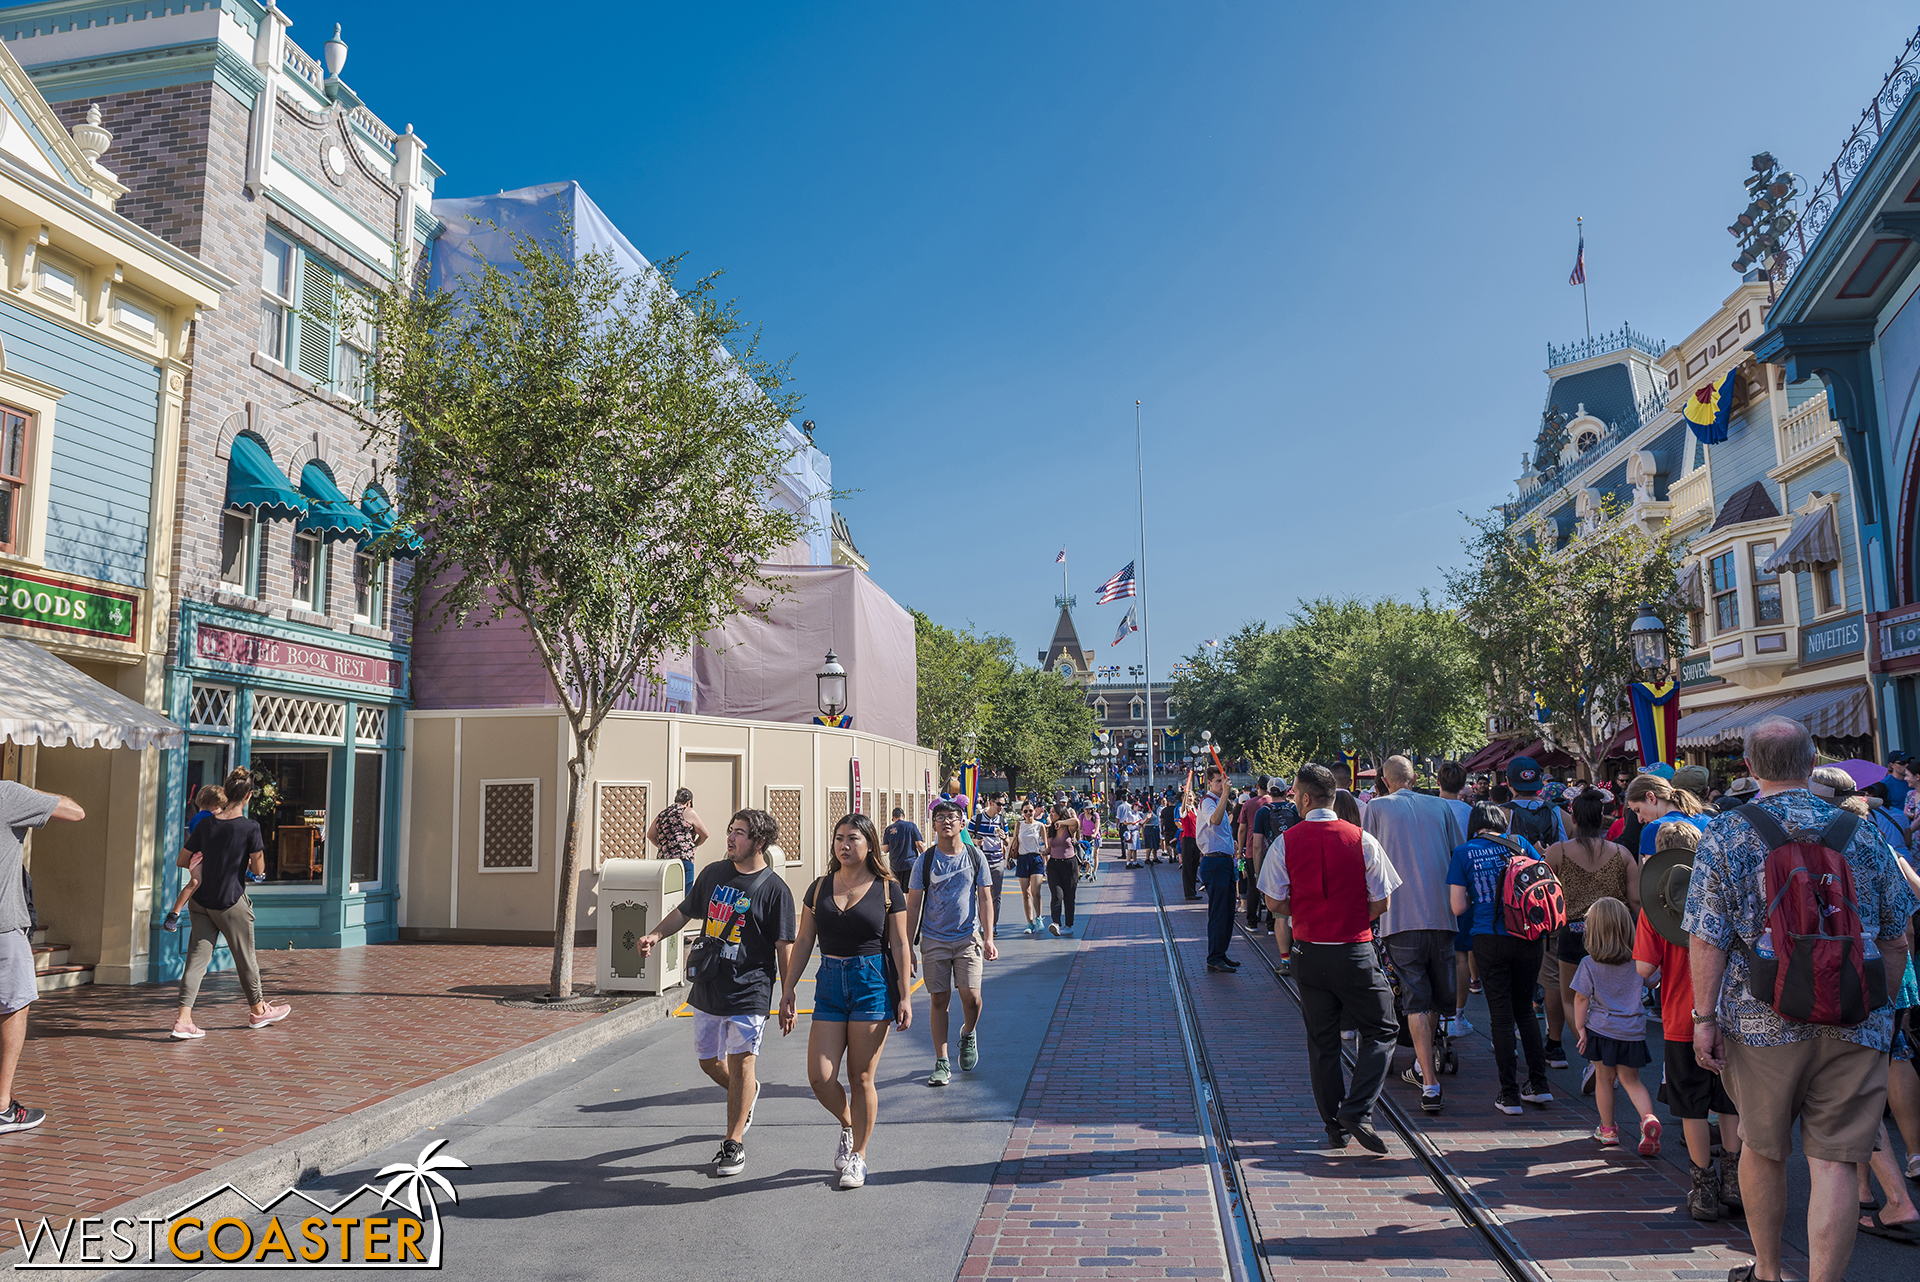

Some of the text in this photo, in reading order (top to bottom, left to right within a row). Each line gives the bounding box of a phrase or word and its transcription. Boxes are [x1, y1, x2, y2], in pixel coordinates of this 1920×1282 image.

[1808, 623, 1859, 654] NOVELTIES
[1900, 628, 1920, 643] 10
[244, 638, 367, 678] THE BOOK REST
[711, 884, 746, 906] NIK
